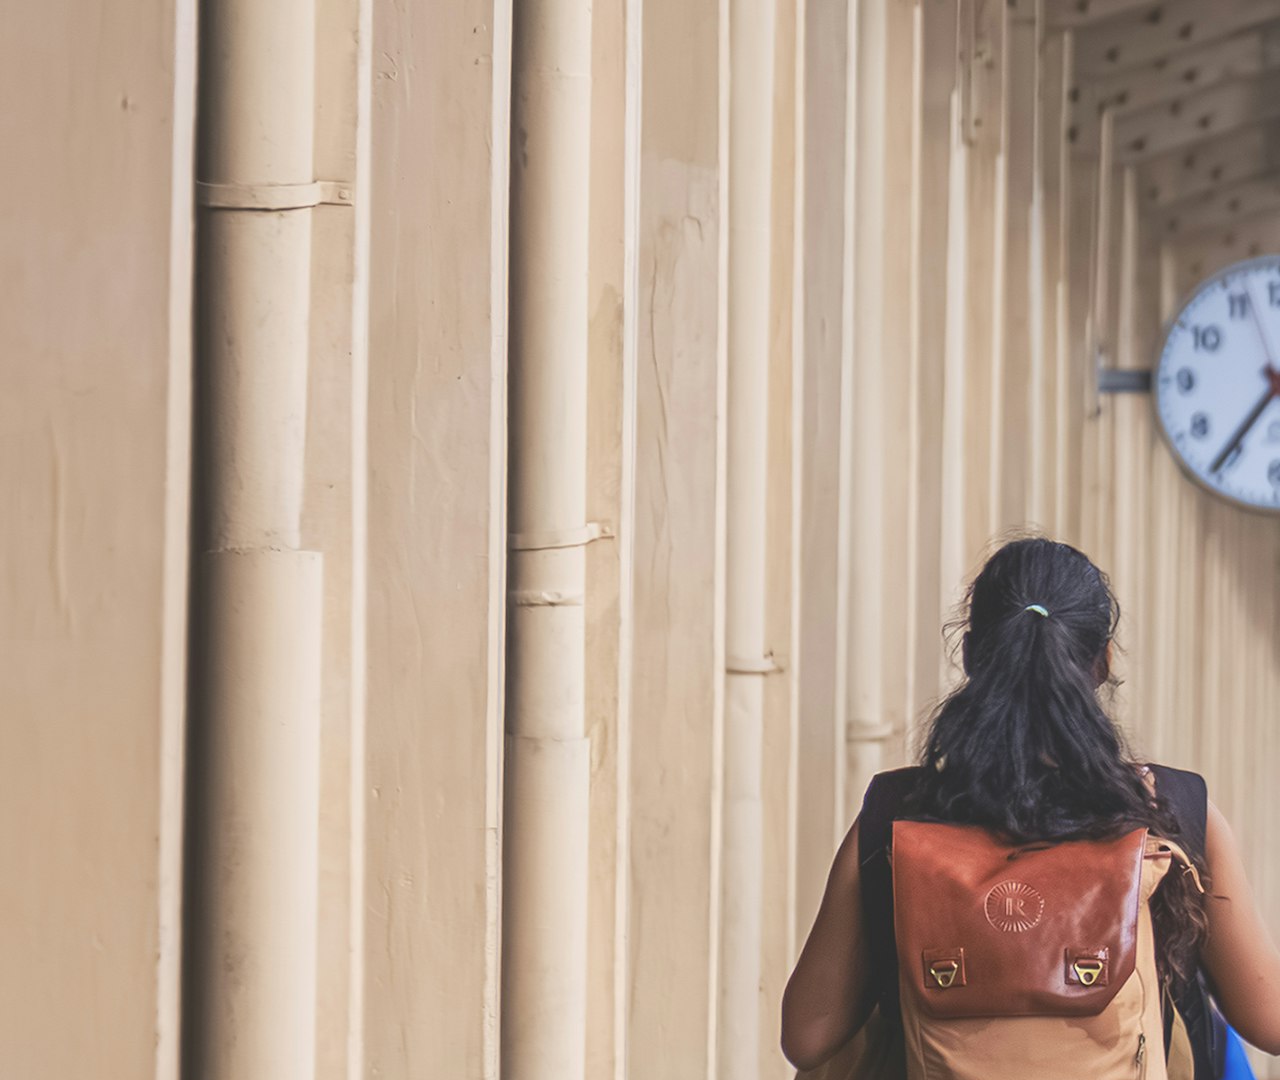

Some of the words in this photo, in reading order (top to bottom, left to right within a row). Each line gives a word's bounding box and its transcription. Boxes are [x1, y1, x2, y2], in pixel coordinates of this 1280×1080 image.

[1228, 294, 1249, 319] 11
[1192, 325, 1221, 351] 10
[1177, 368, 1194, 394] 9
